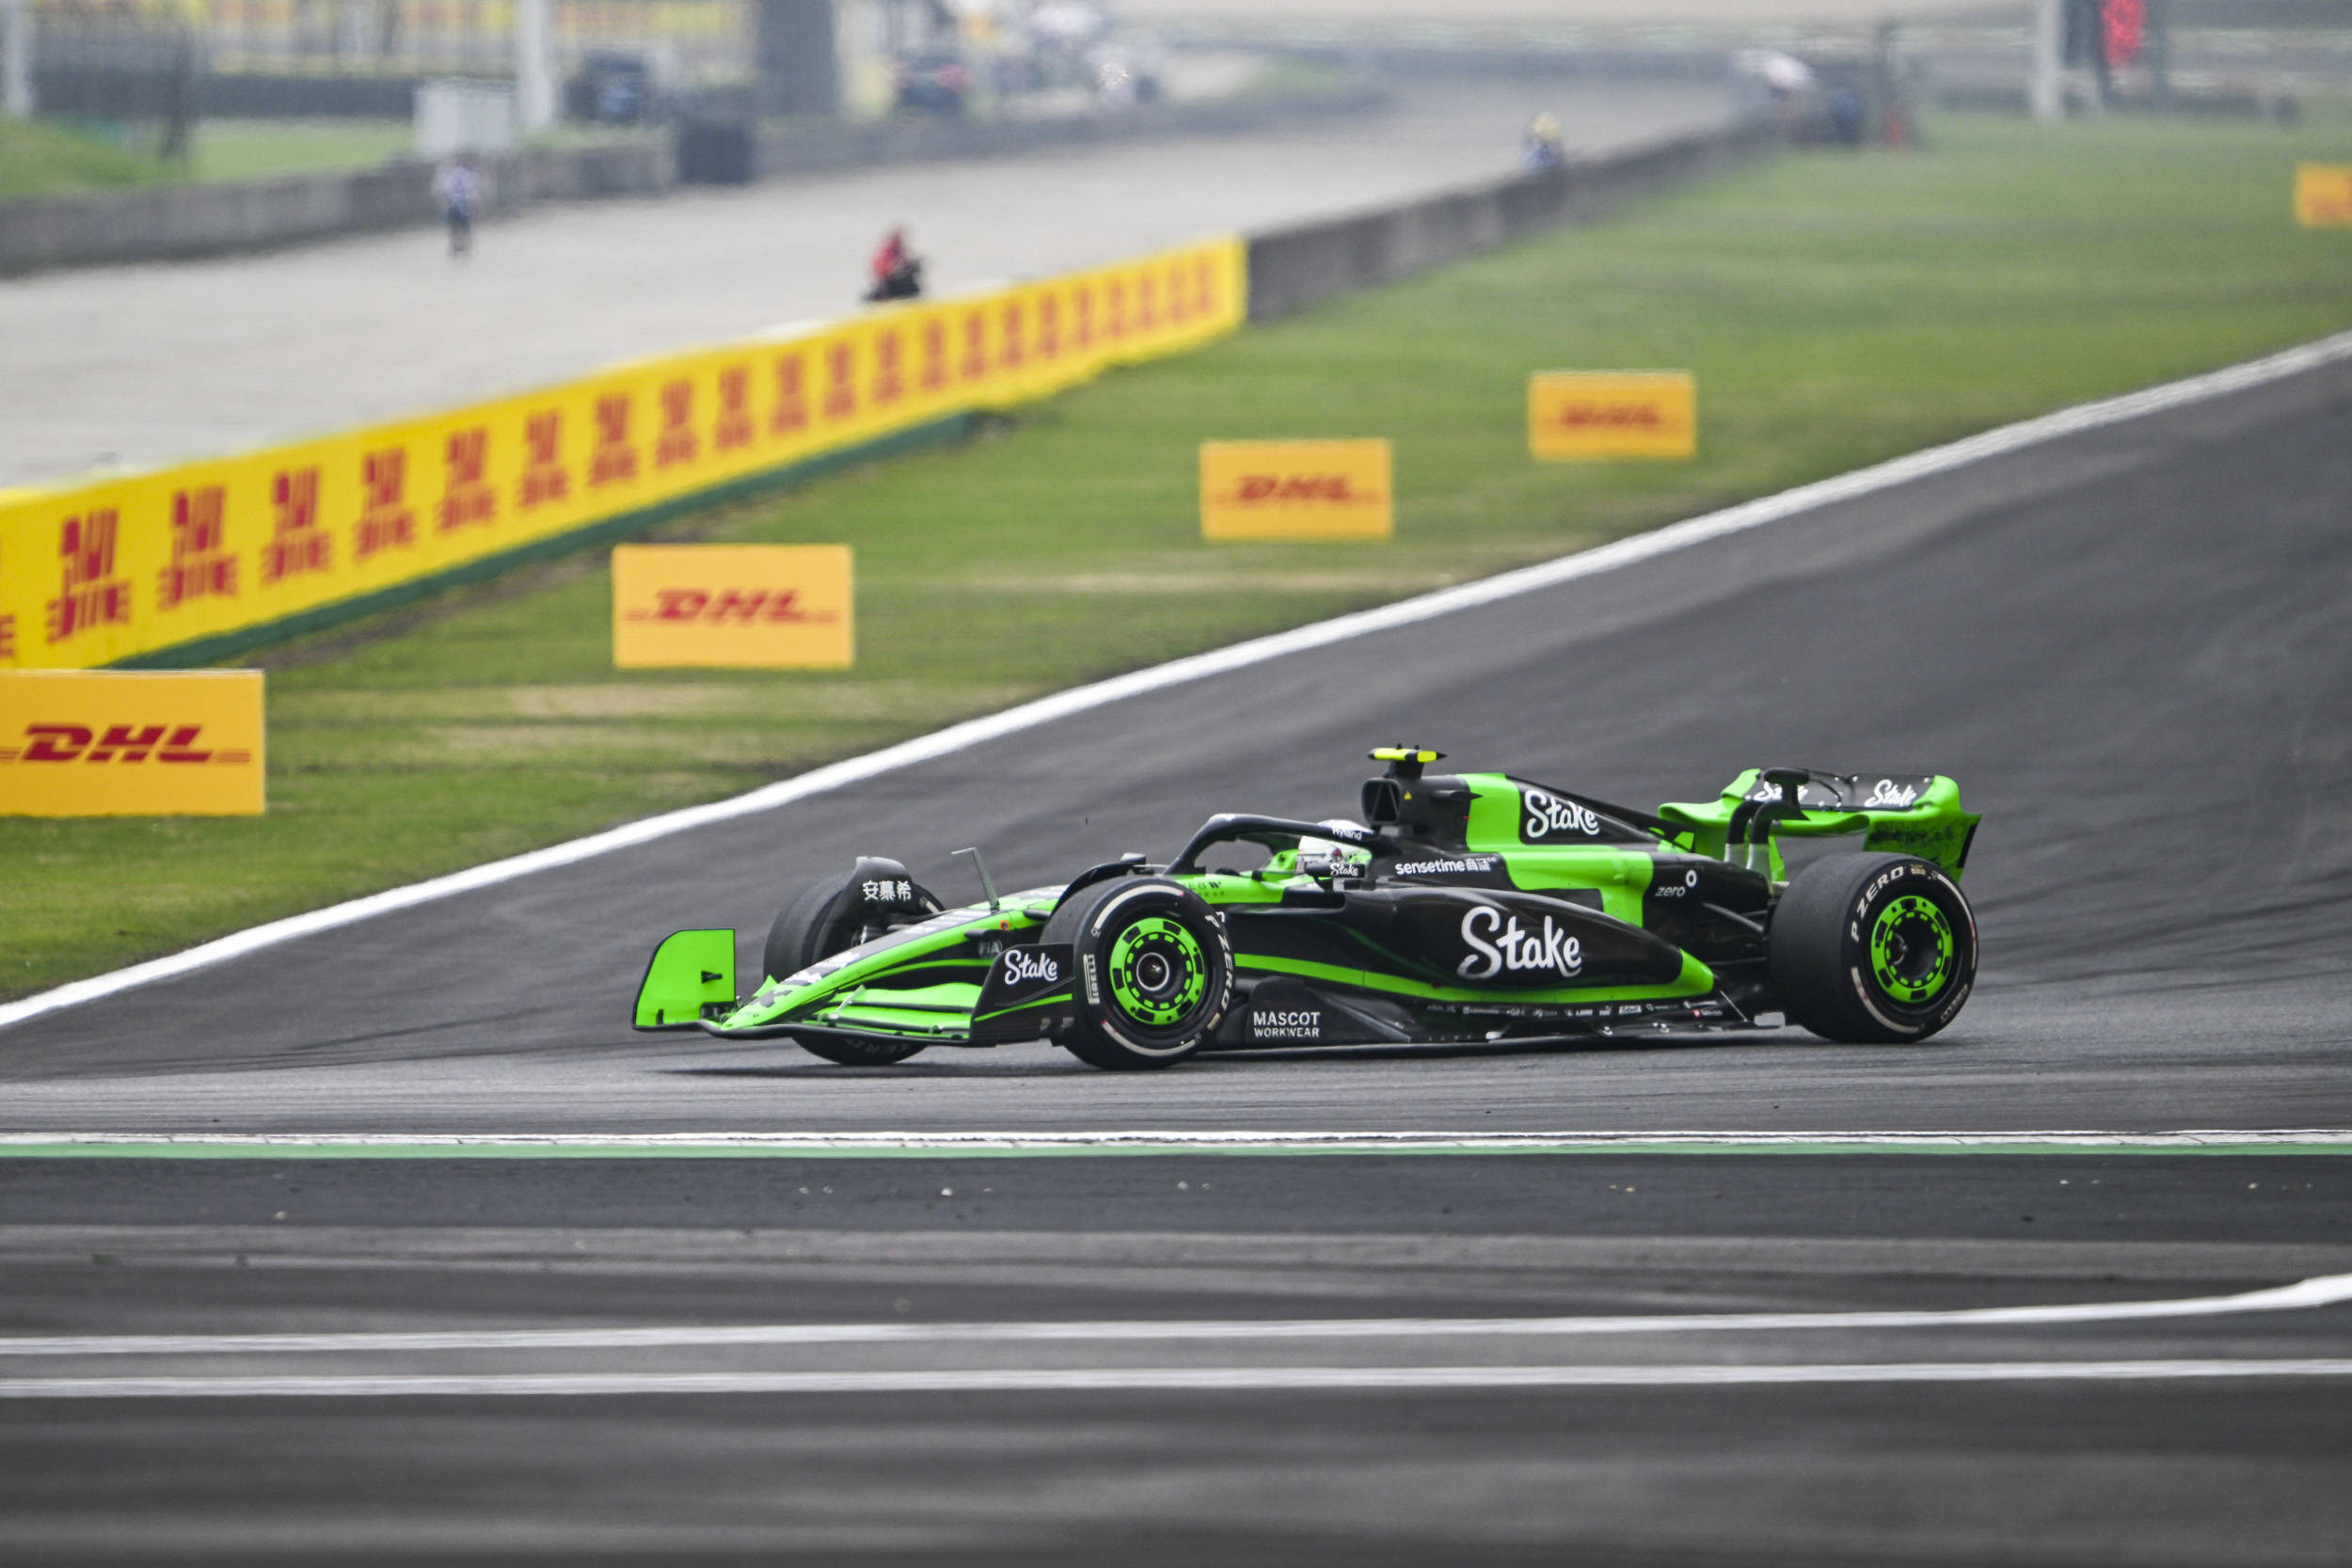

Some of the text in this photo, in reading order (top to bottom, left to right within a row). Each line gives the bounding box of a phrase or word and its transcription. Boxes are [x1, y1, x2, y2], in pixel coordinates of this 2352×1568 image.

[657, 587, 807, 626] DHL
[22, 722, 213, 764] DHL
[1525, 790, 1599, 838] Stake
[1330, 863, 1359, 877] Stake
[1394, 858, 1466, 875] sensetime
[862, 879, 912, 901] 安慕希
[1654, 886, 1686, 897] zero
[1857, 865, 1904, 919] ZERO
[1456, 905, 1582, 978] Stake
[1004, 949, 1058, 986] Stake
[1253, 1011, 1321, 1026] MASCOT
[1253, 1027, 1320, 1038] WORKWEAR
